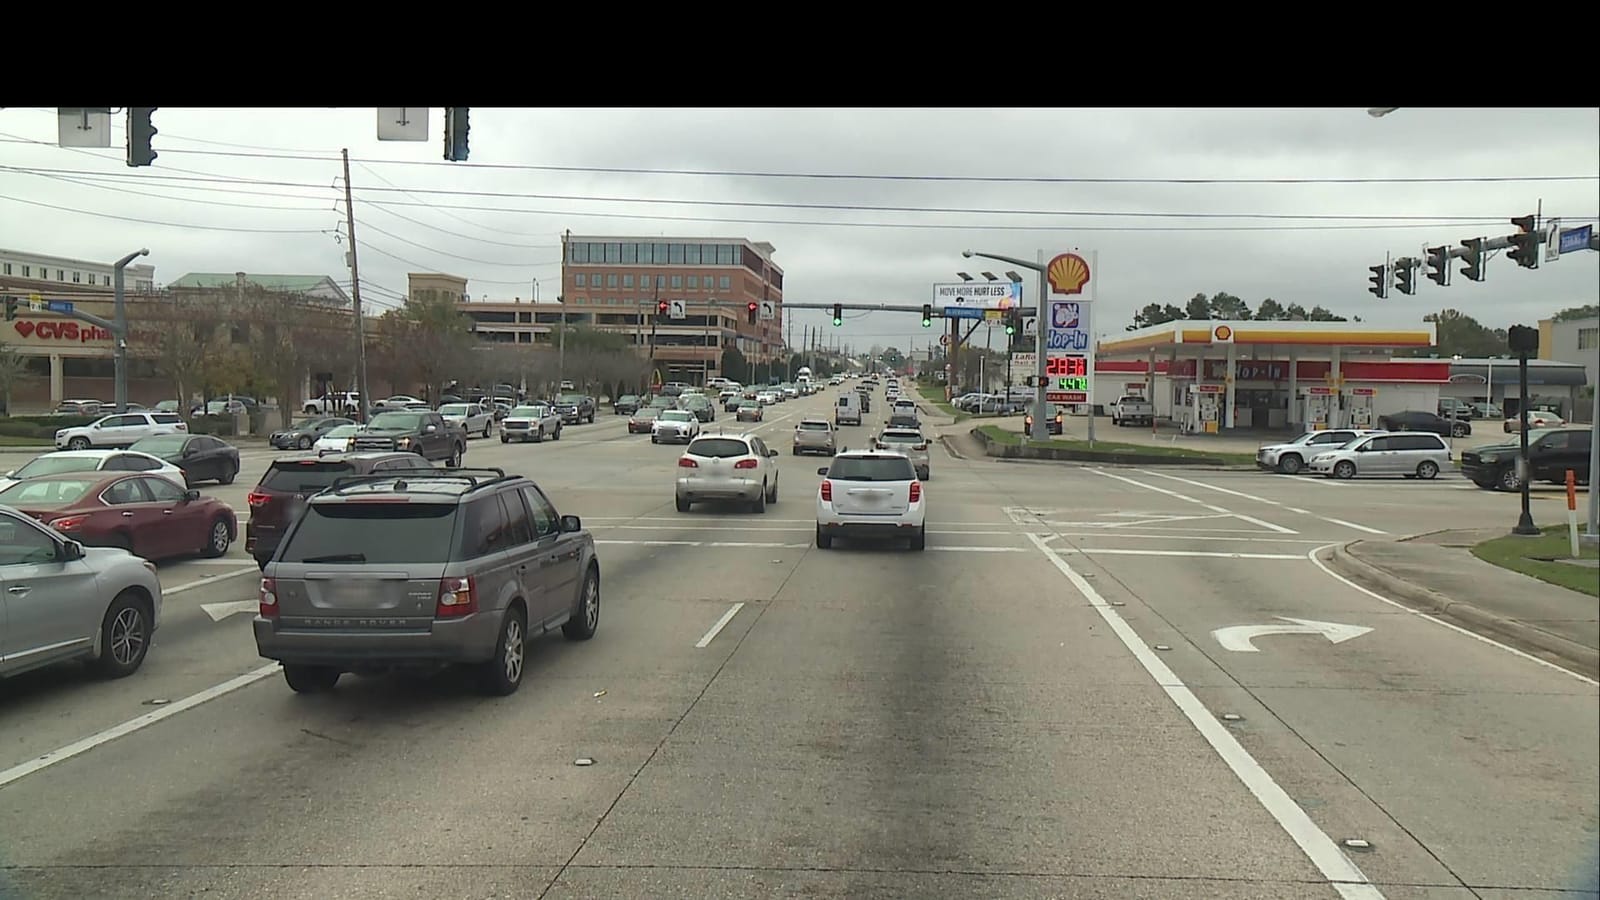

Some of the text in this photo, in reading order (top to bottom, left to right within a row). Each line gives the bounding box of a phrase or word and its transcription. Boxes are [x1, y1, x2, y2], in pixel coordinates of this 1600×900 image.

[939, 287, 1005, 296] MOVE MORE HURT LESS
[36, 322, 79, 340] CVS
